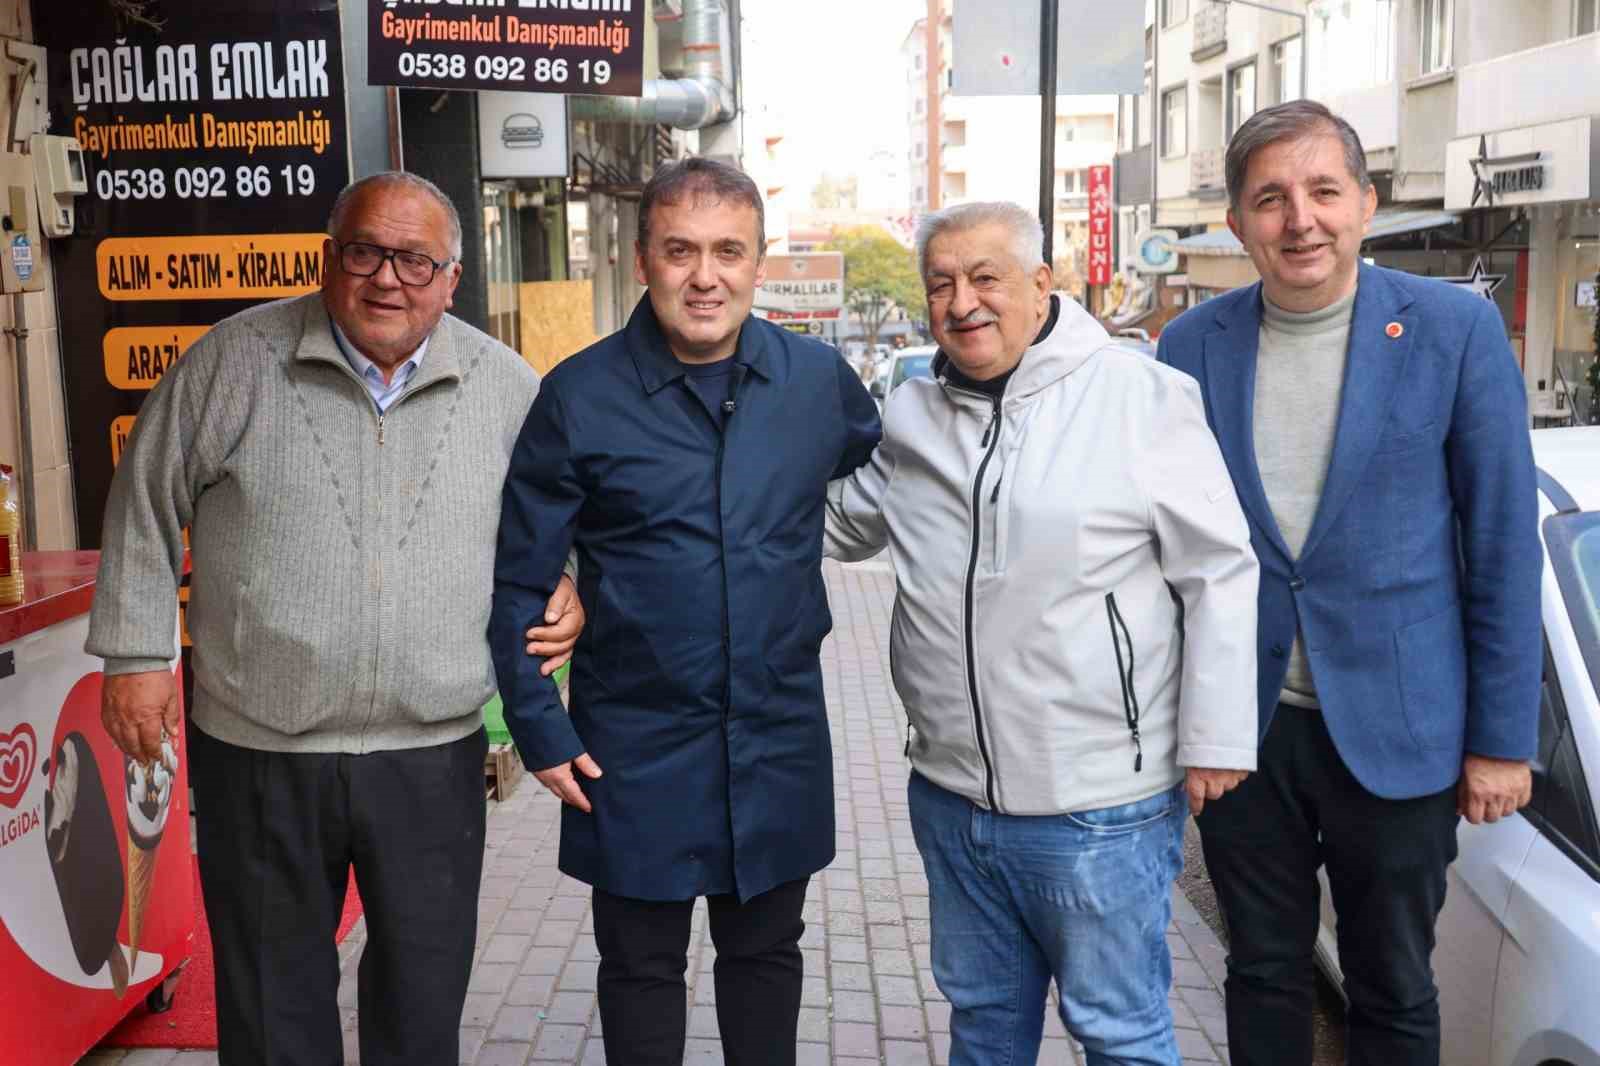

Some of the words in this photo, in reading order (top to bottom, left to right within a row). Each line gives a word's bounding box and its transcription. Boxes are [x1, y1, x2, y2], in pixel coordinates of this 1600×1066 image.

[382, 10, 501, 46] Gayrimenkul
[506, 16, 630, 55] Danışmanlığı
[70, 37, 199, 111] ÇAĞLAR
[210, 39, 329, 101] EMLAK
[398, 52, 466, 80] 0538
[474, 55, 525, 81] 092
[534, 57, 569, 84] 86
[577, 59, 612, 85] 19
[74, 113, 199, 160] Gayrimenkul
[203, 110, 331, 155] Danışmanlığı
[96, 168, 167, 201] 0538
[174, 168, 227, 199] 092
[236, 165, 272, 197] 86
[280, 164, 315, 196] 19
[108, 255, 151, 291] ALIM
[167, 253, 221, 290] SATIM
